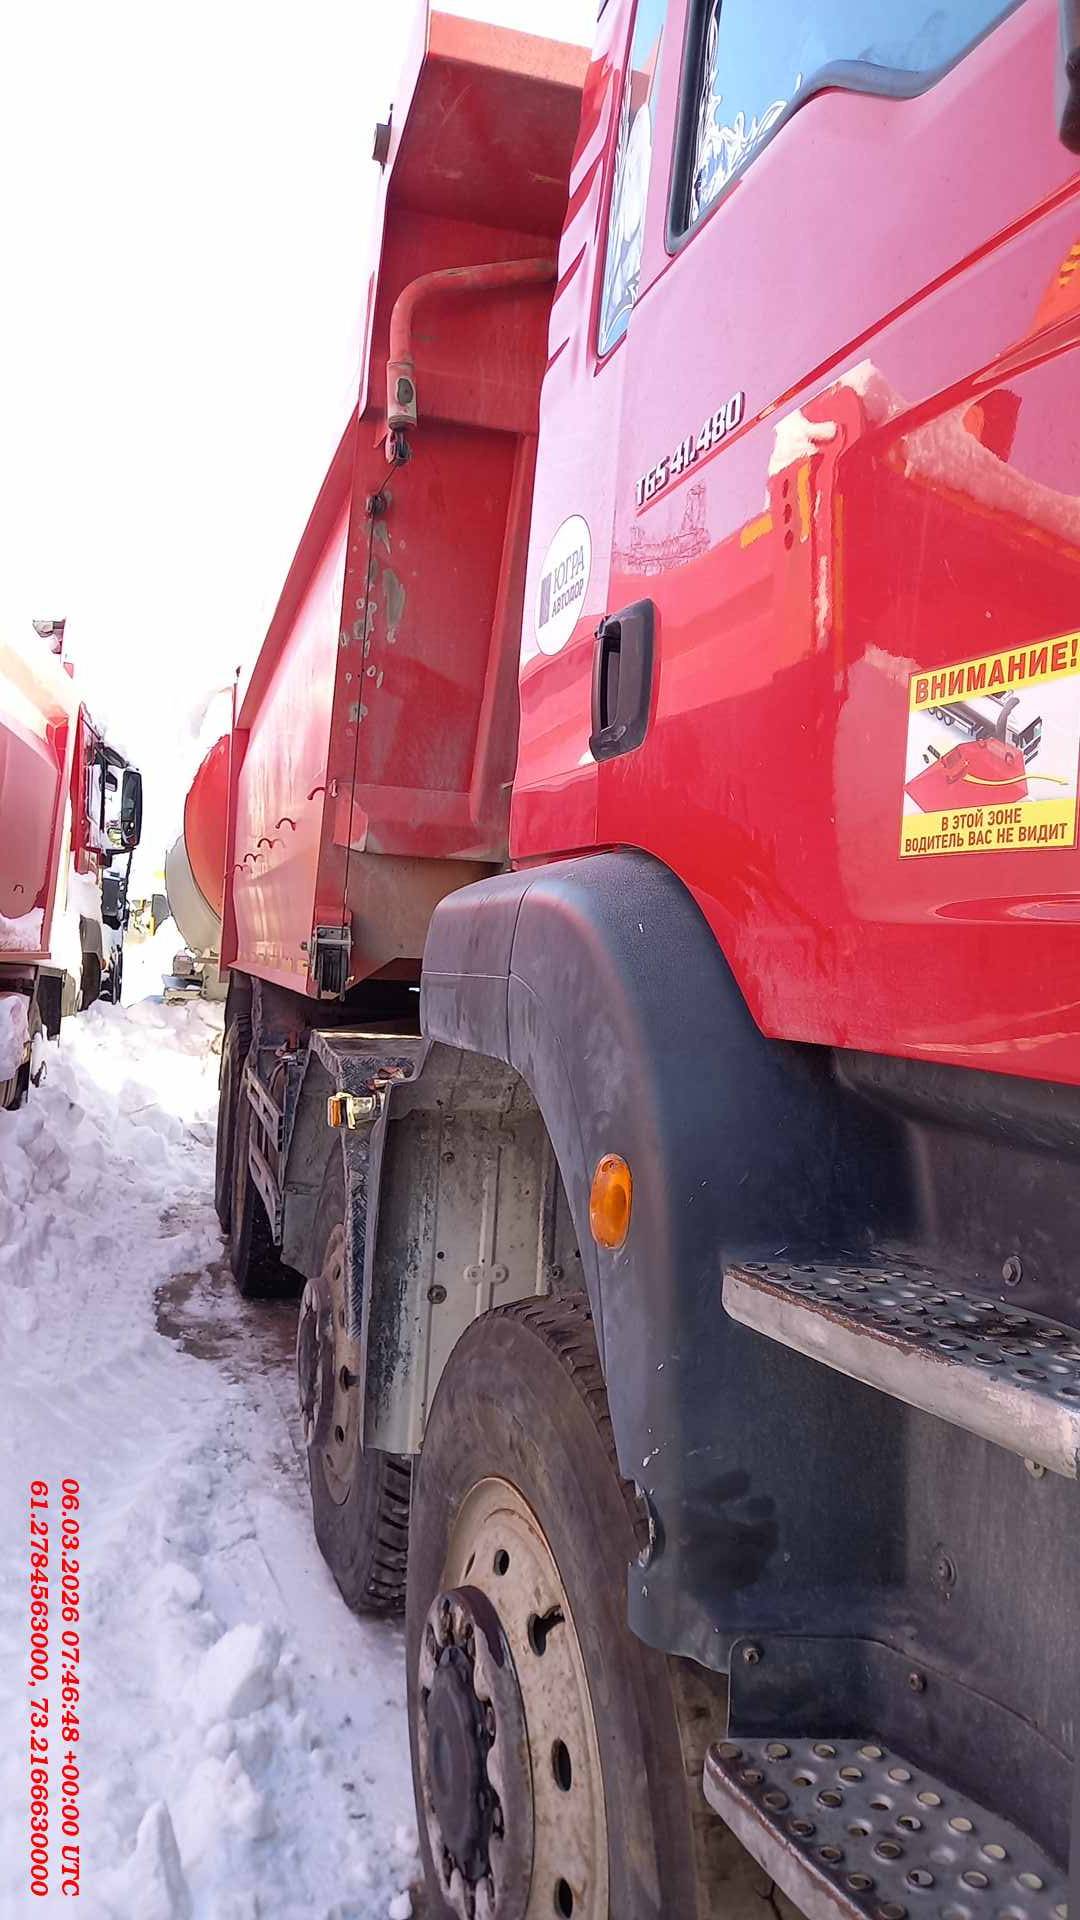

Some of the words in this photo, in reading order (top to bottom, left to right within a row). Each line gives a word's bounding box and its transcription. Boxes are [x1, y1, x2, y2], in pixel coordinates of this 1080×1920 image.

[636, 456, 670, 506] TGS
[671, 391, 745, 474] 41.480
[551, 546, 585, 594] ЮГРА
[551, 578, 584, 618] АВТОДОР
[915, 639, 1078, 704] ВНИМАНИЕ!
[905, 832, 964, 853] ВОДИТЕЛЬ
[968, 829, 992, 845] ВАС
[997, 827, 1014, 843] НЕ
[1018, 822, 1068, 843] ВИДИТ
[941, 817, 947, 831] В
[952, 808, 983, 829] ЭТОЙ
[987, 808, 1022, 826] ЗОНЕ
